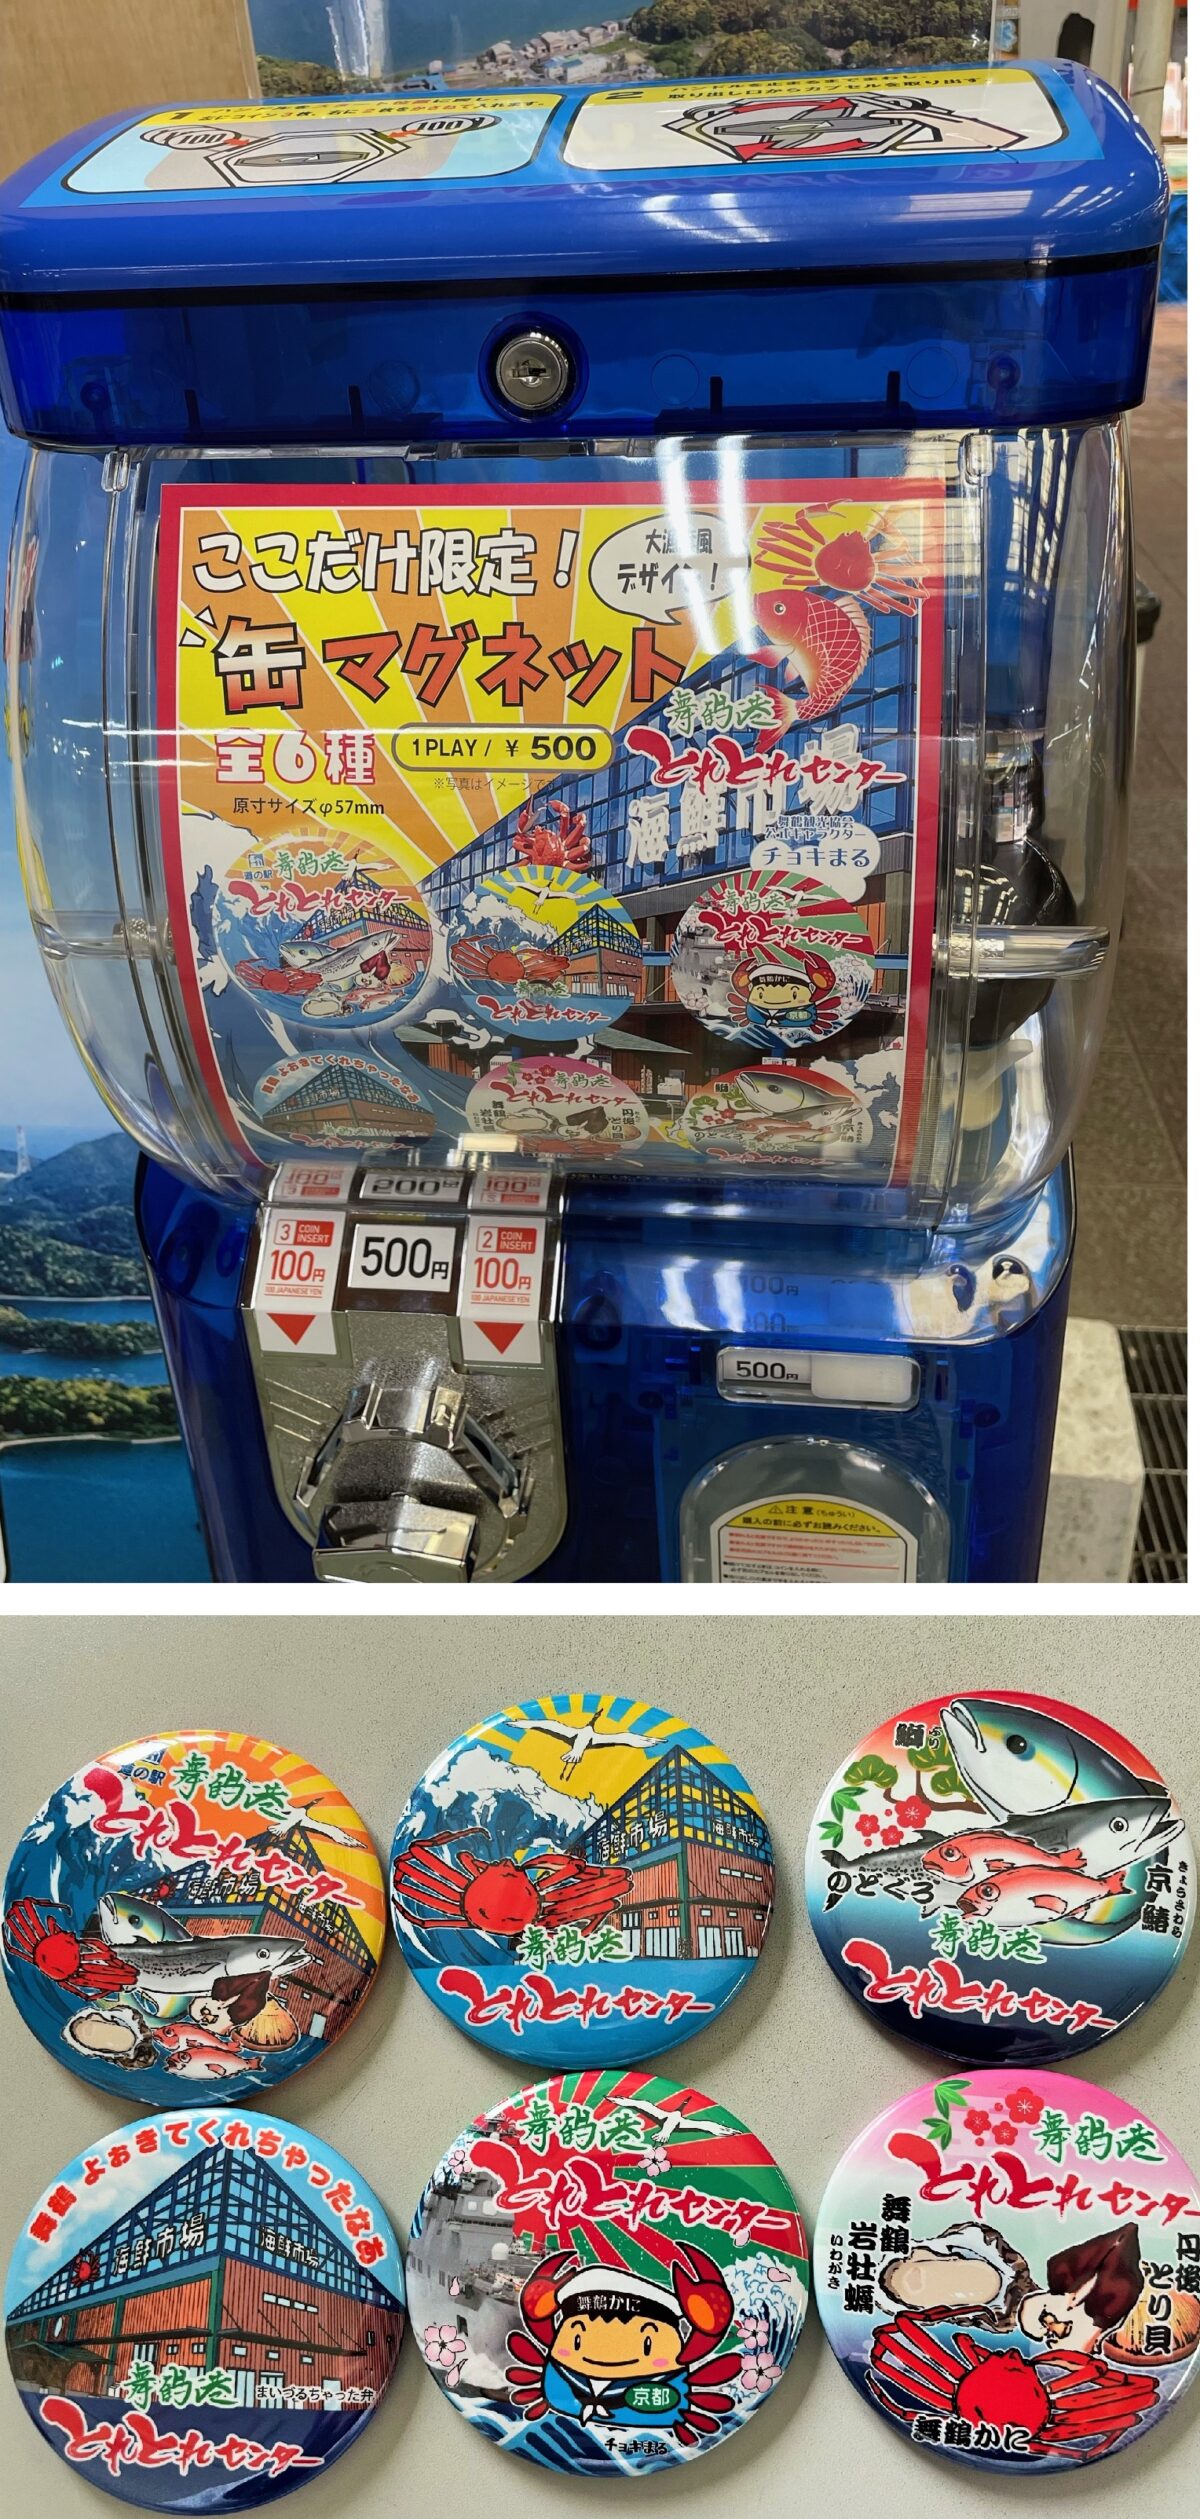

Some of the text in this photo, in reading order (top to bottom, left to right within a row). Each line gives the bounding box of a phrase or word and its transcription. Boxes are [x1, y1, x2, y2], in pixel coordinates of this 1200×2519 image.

[193, 529, 580, 596] ここだけ限定！
[214, 730, 377, 786] 全6種
[531, 736, 597, 760] 500
[765, 827, 866, 840] 公式キャラクター
[762, 846, 870, 868] チョキまる
[280, 1224, 291, 1241] 3
[297, 1233, 330, 1244] INSERT
[299, 1225, 321, 1234] COIN
[483, 1230, 494, 1249] 2
[500, 1240, 533, 1251] INSERT
[501, 1232, 522, 1241] COIN
[271, 1250, 326, 1282] 100円
[361, 1237, 449, 1280] 500円
[474, 1257, 532, 1290] 100円
[736, 1360, 798, 1381] 500円
[172, 1753, 290, 1821] 舞鶴港
[83, 1768, 364, 1908] とれとれセンター
[520, 1927, 632, 1970] 舞鶴港
[931, 1914, 1046, 1963] 舞鶴港
[437, 1968, 715, 2035] とれとれセンター
[842, 1939, 1118, 2034] とれとれセンター
[518, 2101, 650, 2154] 舞鶴港
[1034, 2110, 1167, 2164] 舞鶴港
[469, 2140, 792, 2231] とれとれセンター
[121, 2362, 239, 2410] 舞鶴港
[631, 2386, 671, 2407] 京都
[40, 2396, 324, 2476] とれとれセンター
[912, 2417, 1031, 2452] 舞鶴かに
